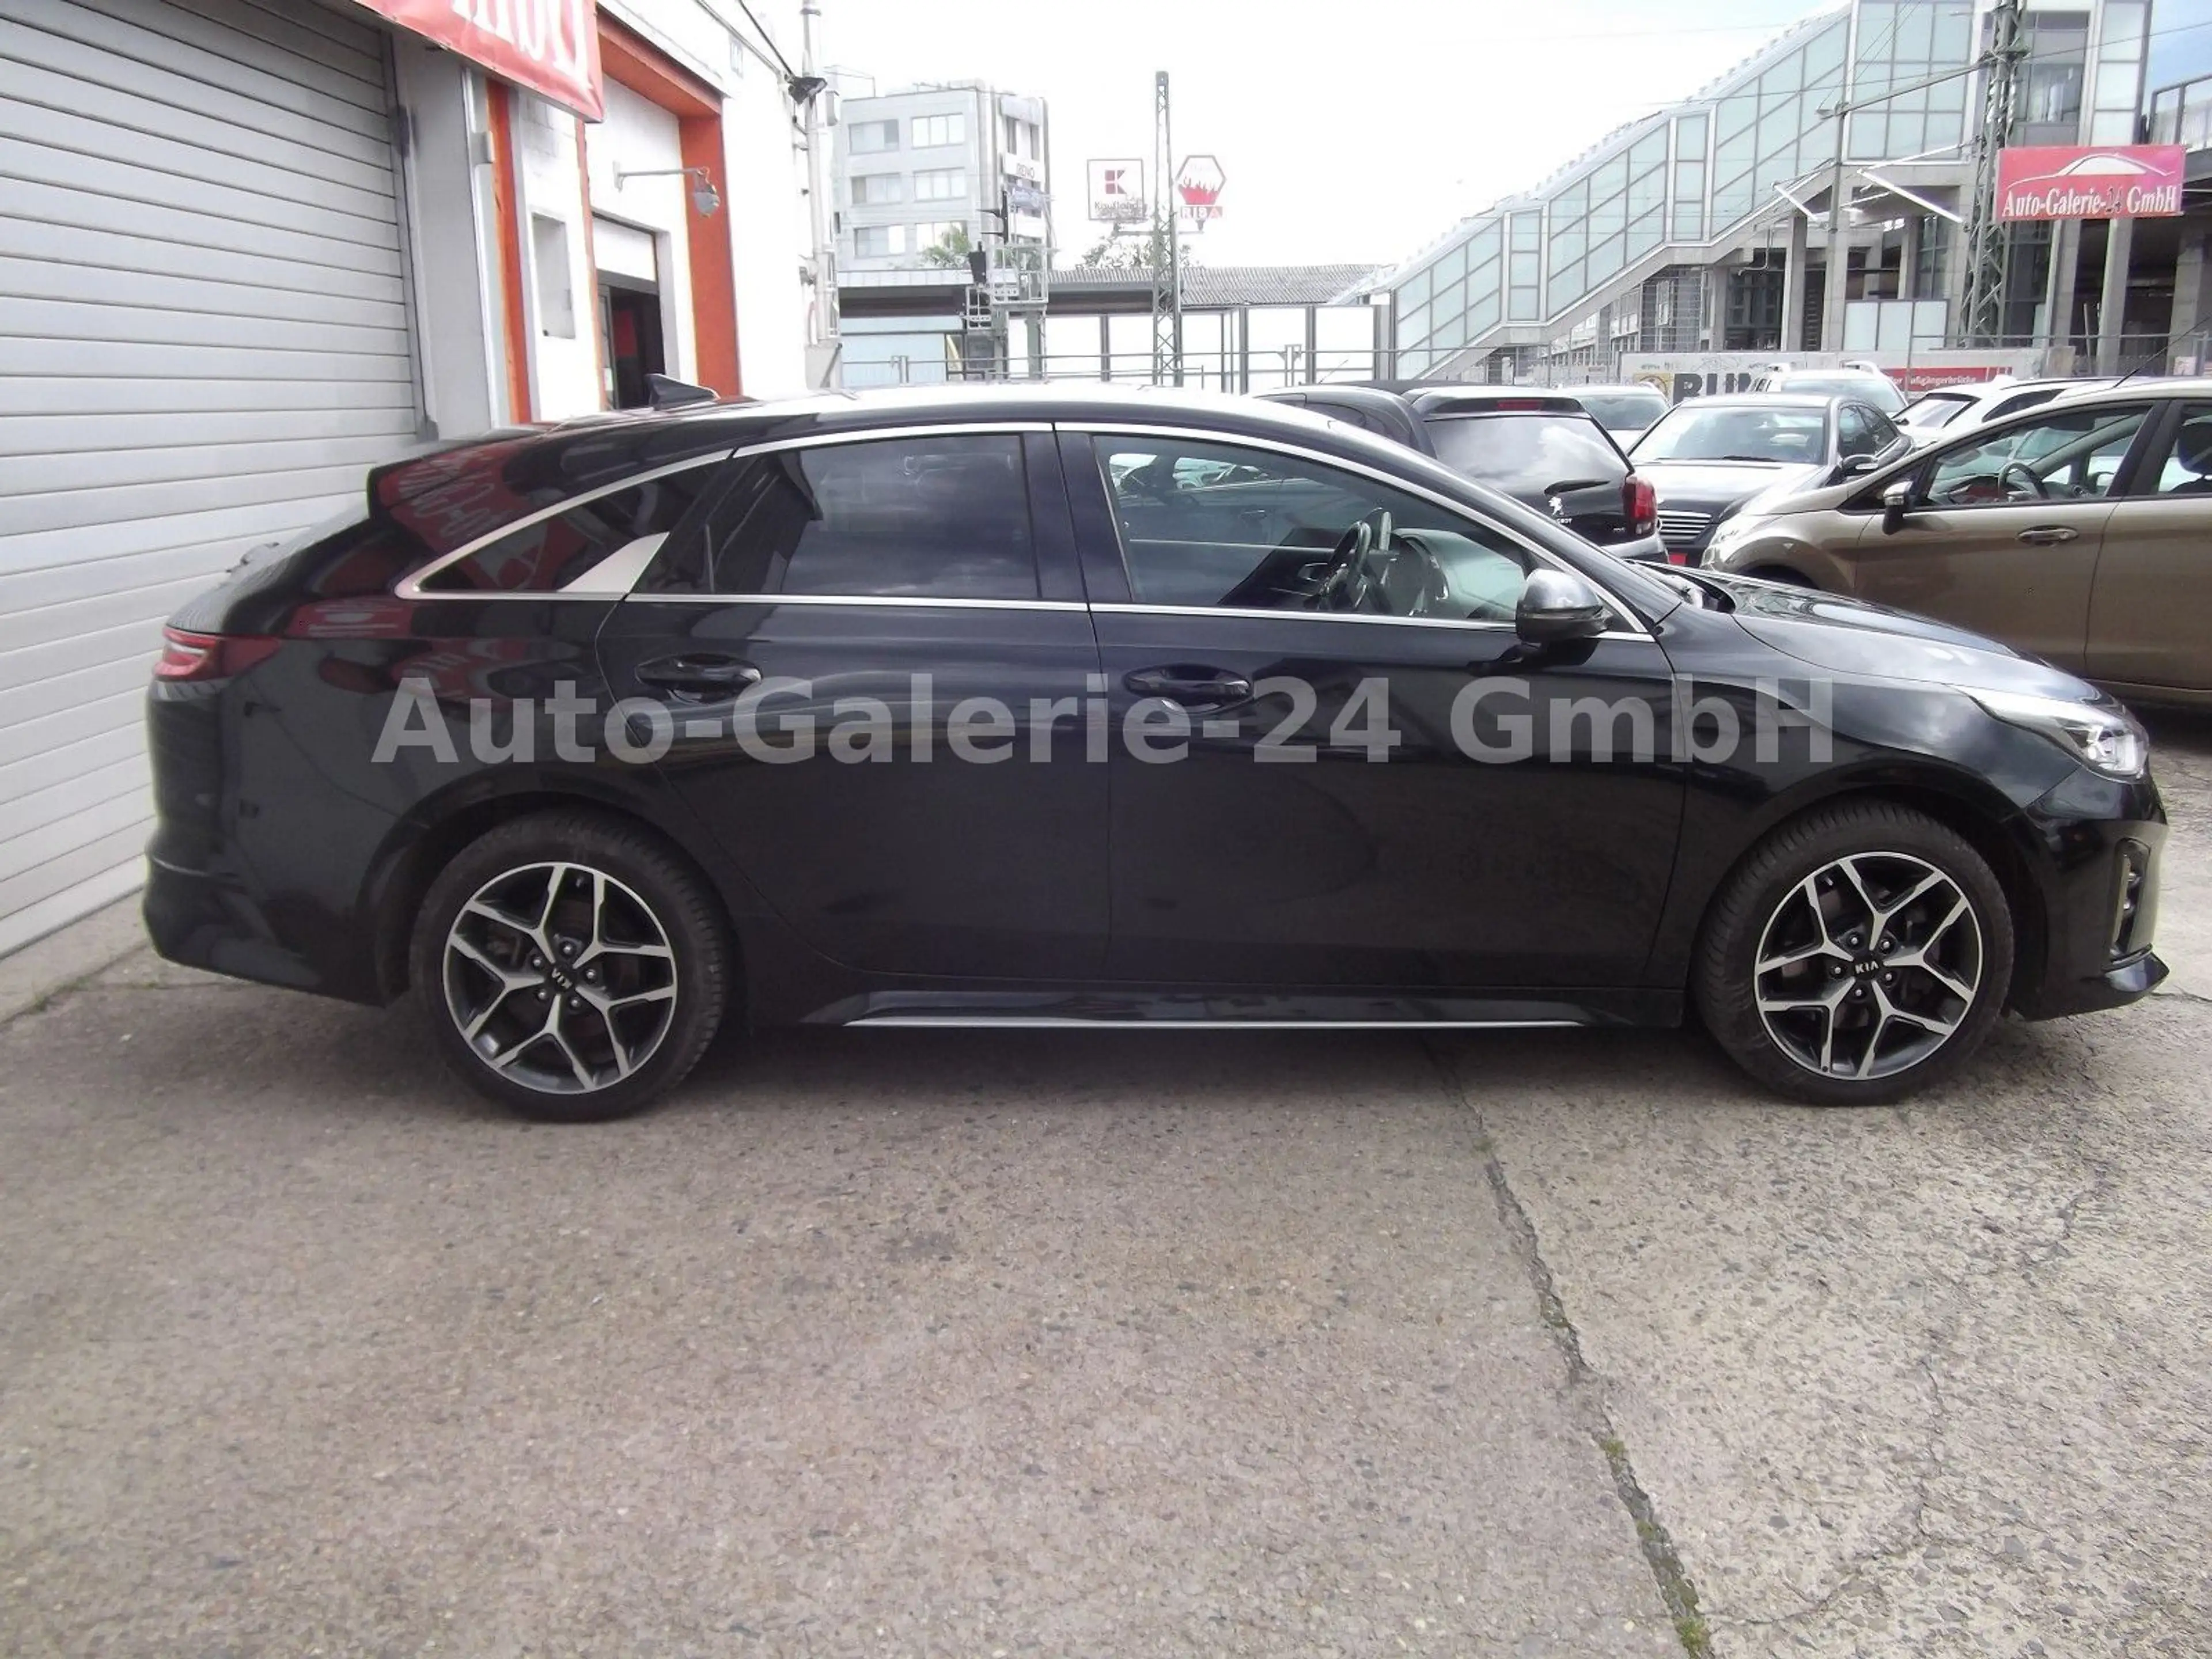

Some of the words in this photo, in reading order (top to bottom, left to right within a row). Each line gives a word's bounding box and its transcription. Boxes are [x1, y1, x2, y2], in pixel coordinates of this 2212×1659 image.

[2002, 186, 2123, 217] Auto-Galerie-24
[2127, 184, 2177, 214] GmbH
[1855, 960, 1879, 975] KIA
